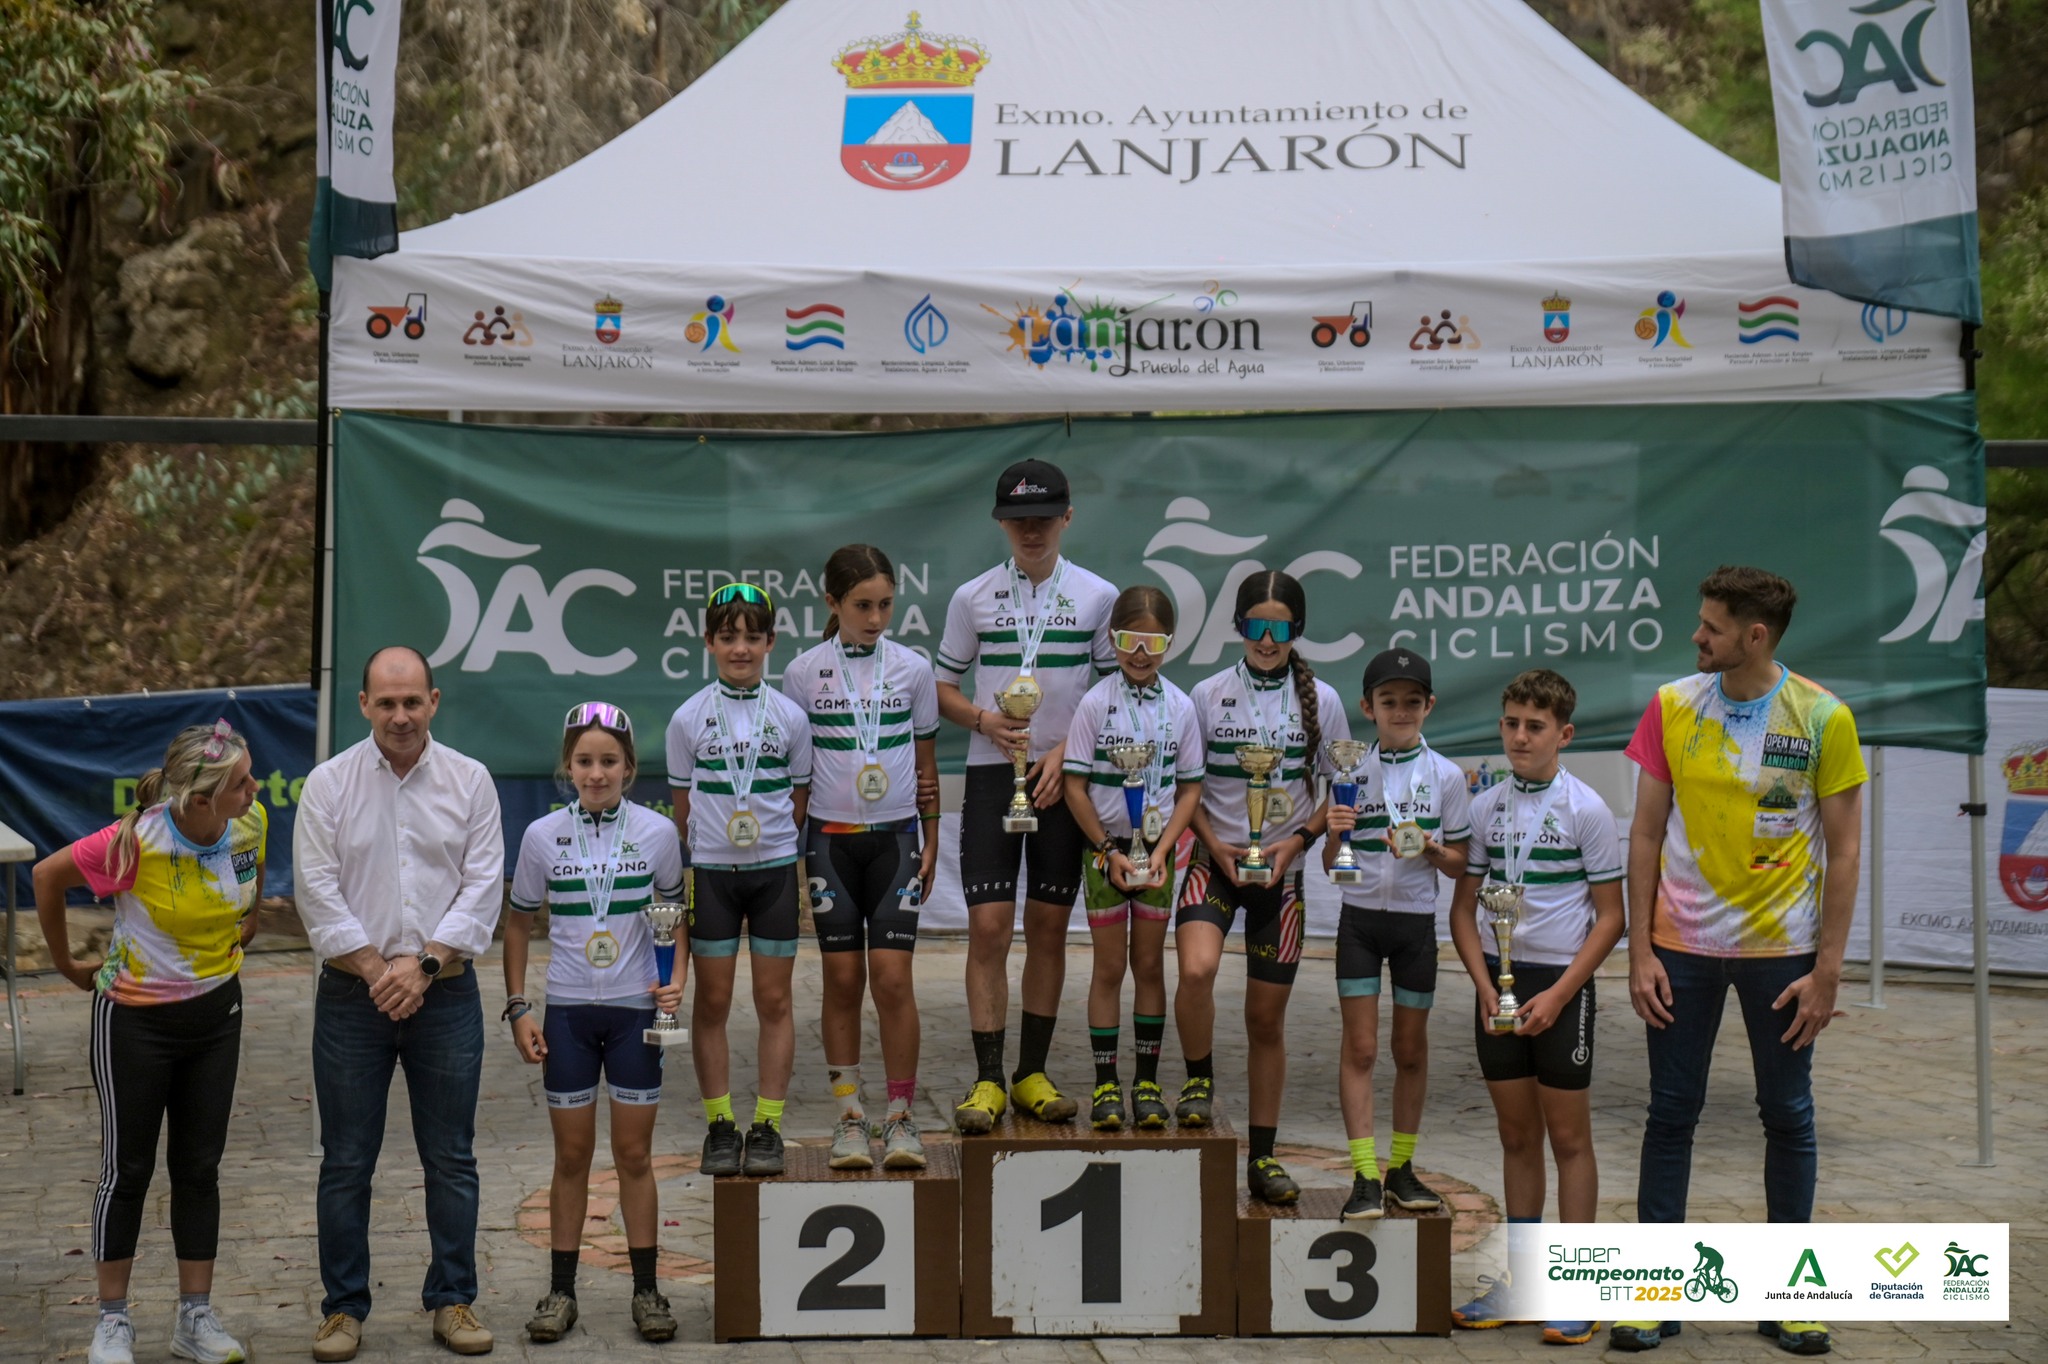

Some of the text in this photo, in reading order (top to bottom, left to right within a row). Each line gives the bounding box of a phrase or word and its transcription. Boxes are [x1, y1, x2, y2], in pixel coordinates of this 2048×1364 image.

[332, 79, 370, 108] ACIÓN
[995, 98, 1469, 132] Exmo. Ayuntamiento de
[994, 122, 1473, 184] LANJARÓN
[562, 352, 653, 370] LANJARÓN
[1511, 352, 1604, 370] LANJARÓN
[1537, 345, 1592, 353] Ayuntamiento
[1140, 357, 1265, 379] Pueblo del Agua
[1390, 530, 1660, 579] FEDERACIÓN
[663, 562, 929, 600] FEDERAN
[1390, 577, 1662, 621] ANDALUZA
[1389, 618, 1664, 661] CICLISMO
[708, 741, 780, 755] CPÓN
[1215, 727, 1306, 742] CAMPNA
[1766, 734, 1789, 748] OPEN
[1790, 738, 1809, 752] MTB
[1040, 1161, 1122, 1304] 1
[797, 1204, 886, 1311] 2
[1304, 1230, 1379, 1321] 3
